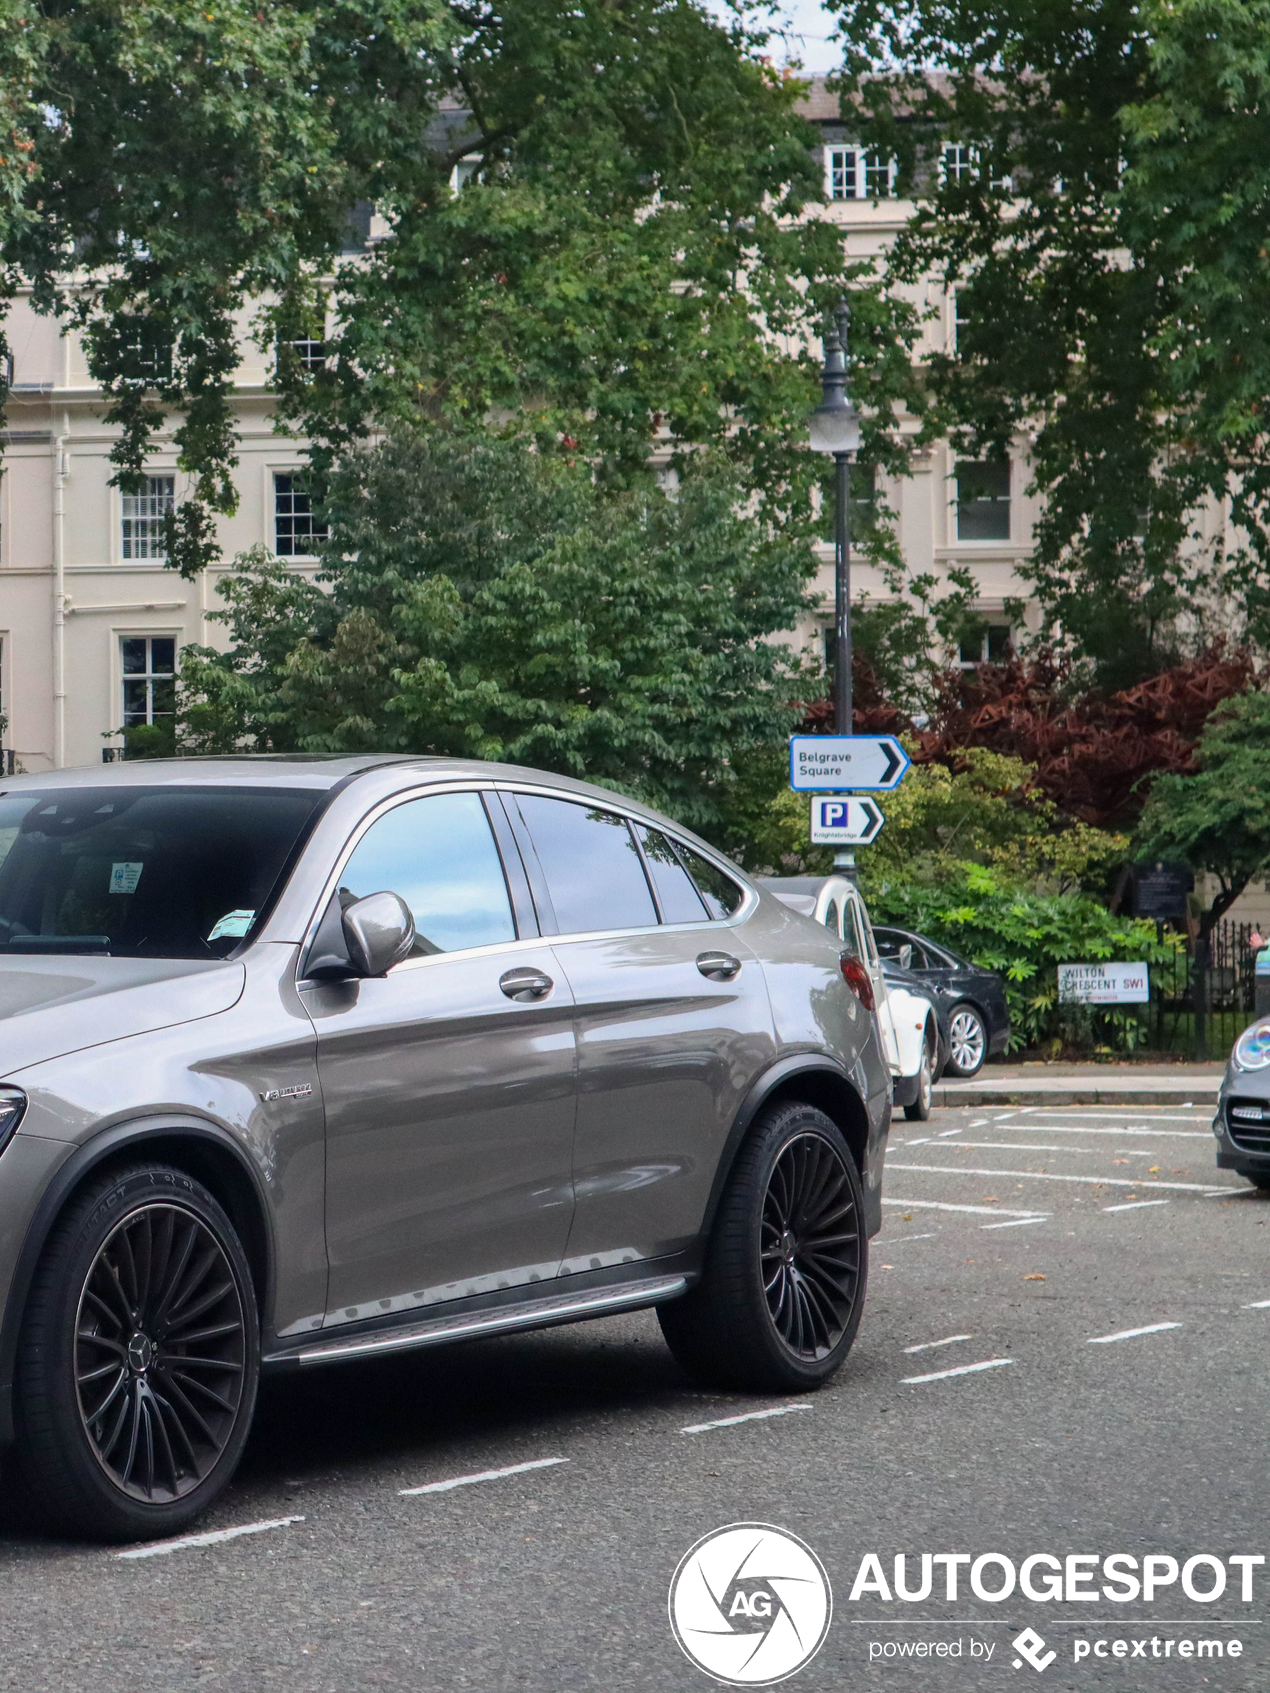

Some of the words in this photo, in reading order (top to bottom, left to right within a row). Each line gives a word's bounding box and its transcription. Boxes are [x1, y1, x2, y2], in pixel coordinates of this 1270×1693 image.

[799, 752, 852, 763] Belgrave
[799, 766, 842, 777] Square
[825, 803, 844, 826] P
[1066, 967, 1105, 978] WILTON
[1065, 979, 1116, 990] CRESCENT
[1123, 978, 1143, 989] SW1
